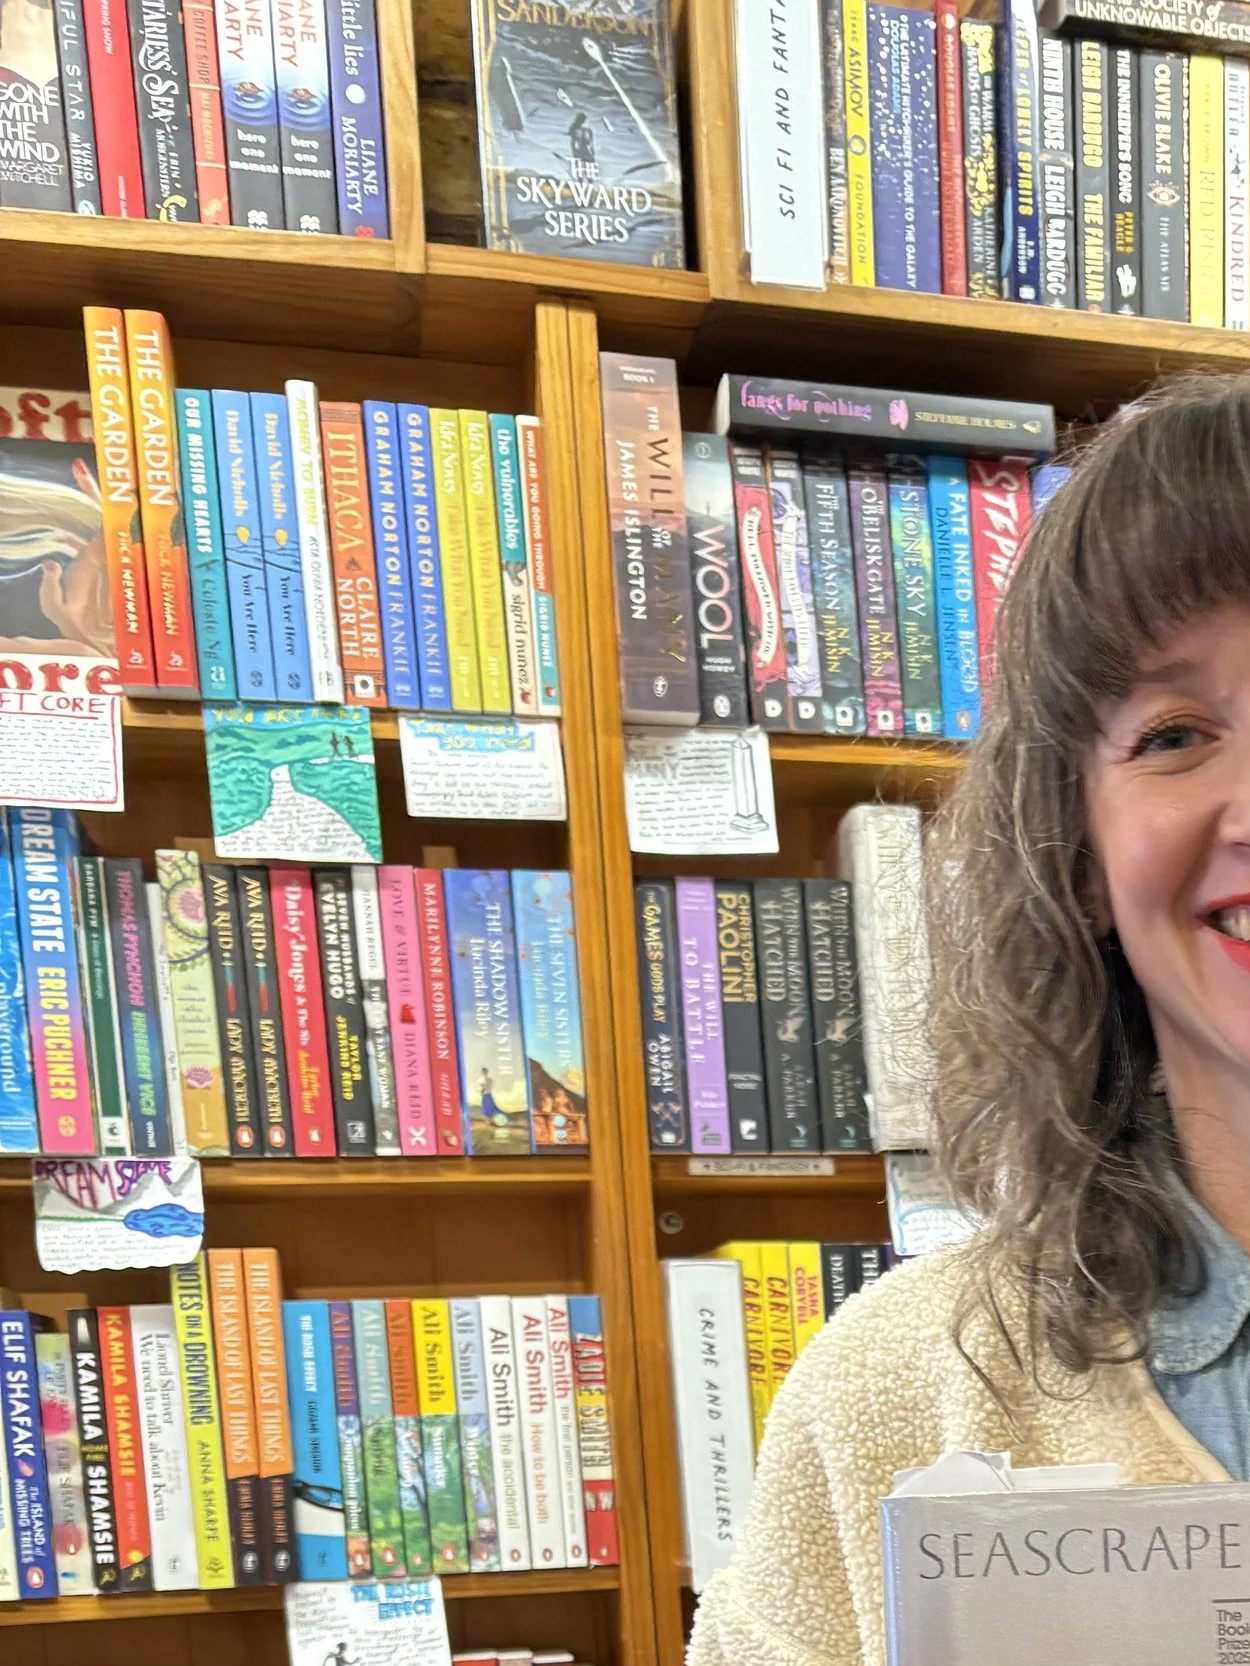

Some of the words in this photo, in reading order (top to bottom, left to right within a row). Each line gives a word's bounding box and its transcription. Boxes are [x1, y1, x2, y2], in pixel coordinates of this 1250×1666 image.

[1075, 4, 1196, 32] UNKNOWABLE
[846, 46, 867, 117] ASIMOV
[1042, 39, 1064, 92] NINTH
[1082, 41, 1101, 88] LEIGH
[0, 123, 36, 142] THE
[774, 87, 792, 135] AND
[1044, 94, 1064, 150] HOUSE
[1083, 92, 1102, 168] BARDUGO
[0, 142, 60, 162] WIND
[341, 117, 363, 214] MORIARTY
[362, 138, 376, 197] LIANE
[565, 157, 600, 178] THE
[777, 151, 793, 172] FI
[517, 177, 652, 216] SKYWARD
[778, 186, 796, 219] SCI
[1044, 165, 1065, 215] LEIGH
[1084, 194, 1102, 225] THE
[545, 211, 630, 244] SERIES
[1230, 195, 1245, 302] KINDRED
[1085, 227, 1105, 302] FAMILIAR
[93, 326, 121, 377] THE
[134, 329, 160, 381] THE
[185, 398, 201, 426] OUR
[787, 393, 809, 414] for
[813, 392, 872, 422] nothing
[99, 385, 132, 502] GARDEN
[139, 388, 172, 505] GARDEN
[188, 433, 207, 494] MISSING
[373, 411, 396, 496] GRAHAM
[616, 440, 638, 501] JAMES
[327, 432, 364, 551] ITHACA
[648, 438, 673, 522] WILL
[193, 500, 212, 553] HEARTS
[379, 502, 402, 586] NORTON
[900, 489, 920, 566] STONE
[950, 496, 966, 535] FATE
[624, 510, 647, 620] ISLINGTON
[693, 526, 732, 649] WOOL
[904, 571, 925, 616] SKY
[953, 544, 969, 601] INKED
[338, 579, 361, 656] NORTH
[354, 578, 379, 659] CLAIRE
[960, 632, 977, 693] BLOOD
[41, 695, 106, 715] CORE
[20, 810, 59, 882] DREAM
[26, 887, 65, 952] STATE
[209, 875, 230, 908] AVA
[321, 885, 340, 949] EVELYN
[485, 902, 501, 936] THE
[214, 912, 234, 949] REID
[424, 883, 445, 973] MARILYNNE
[683, 938, 699, 965] TO
[716, 893, 745, 1002] PAOLINI
[738, 894, 756, 1003] CHRISTOPHER
[37, 967, 69, 1015] ERIC
[327, 953, 343, 1000] HUGO
[489, 940, 510, 1023] SHADOW
[431, 977, 448, 1060] ROBINSON
[686, 979, 705, 1064] BATTLE
[43, 1018, 77, 1100] PUCHNER
[497, 1025, 513, 1075] SISTER
[2, 1321, 26, 1364] ELIF
[107, 1313, 124, 1385] KAMILA
[490, 1328, 509, 1355] Ali
[523, 1314, 541, 1344] Ali
[548, 1308, 565, 1333] Ali
[699, 1308, 718, 1367] CRIME
[76, 1352, 103, 1440] KAMILA
[182, 1342, 214, 1426] DROWNING
[493, 1362, 516, 1426] Smith
[526, 1350, 547, 1415] Smith
[551, 1341, 570, 1399] Smith
[6, 1372, 35, 1456] SHAFAK
[705, 1382, 721, 1420] AND
[113, 1395, 136, 1476] SHAMSIE
[197, 1440, 212, 1485] ANNA
[87, 1466, 114, 1565] SHAMSIE
[201, 1489, 220, 1542] SHARPE
[711, 1436, 733, 1541] THRILLERS
[1216, 1609, 1243, 1623] The
